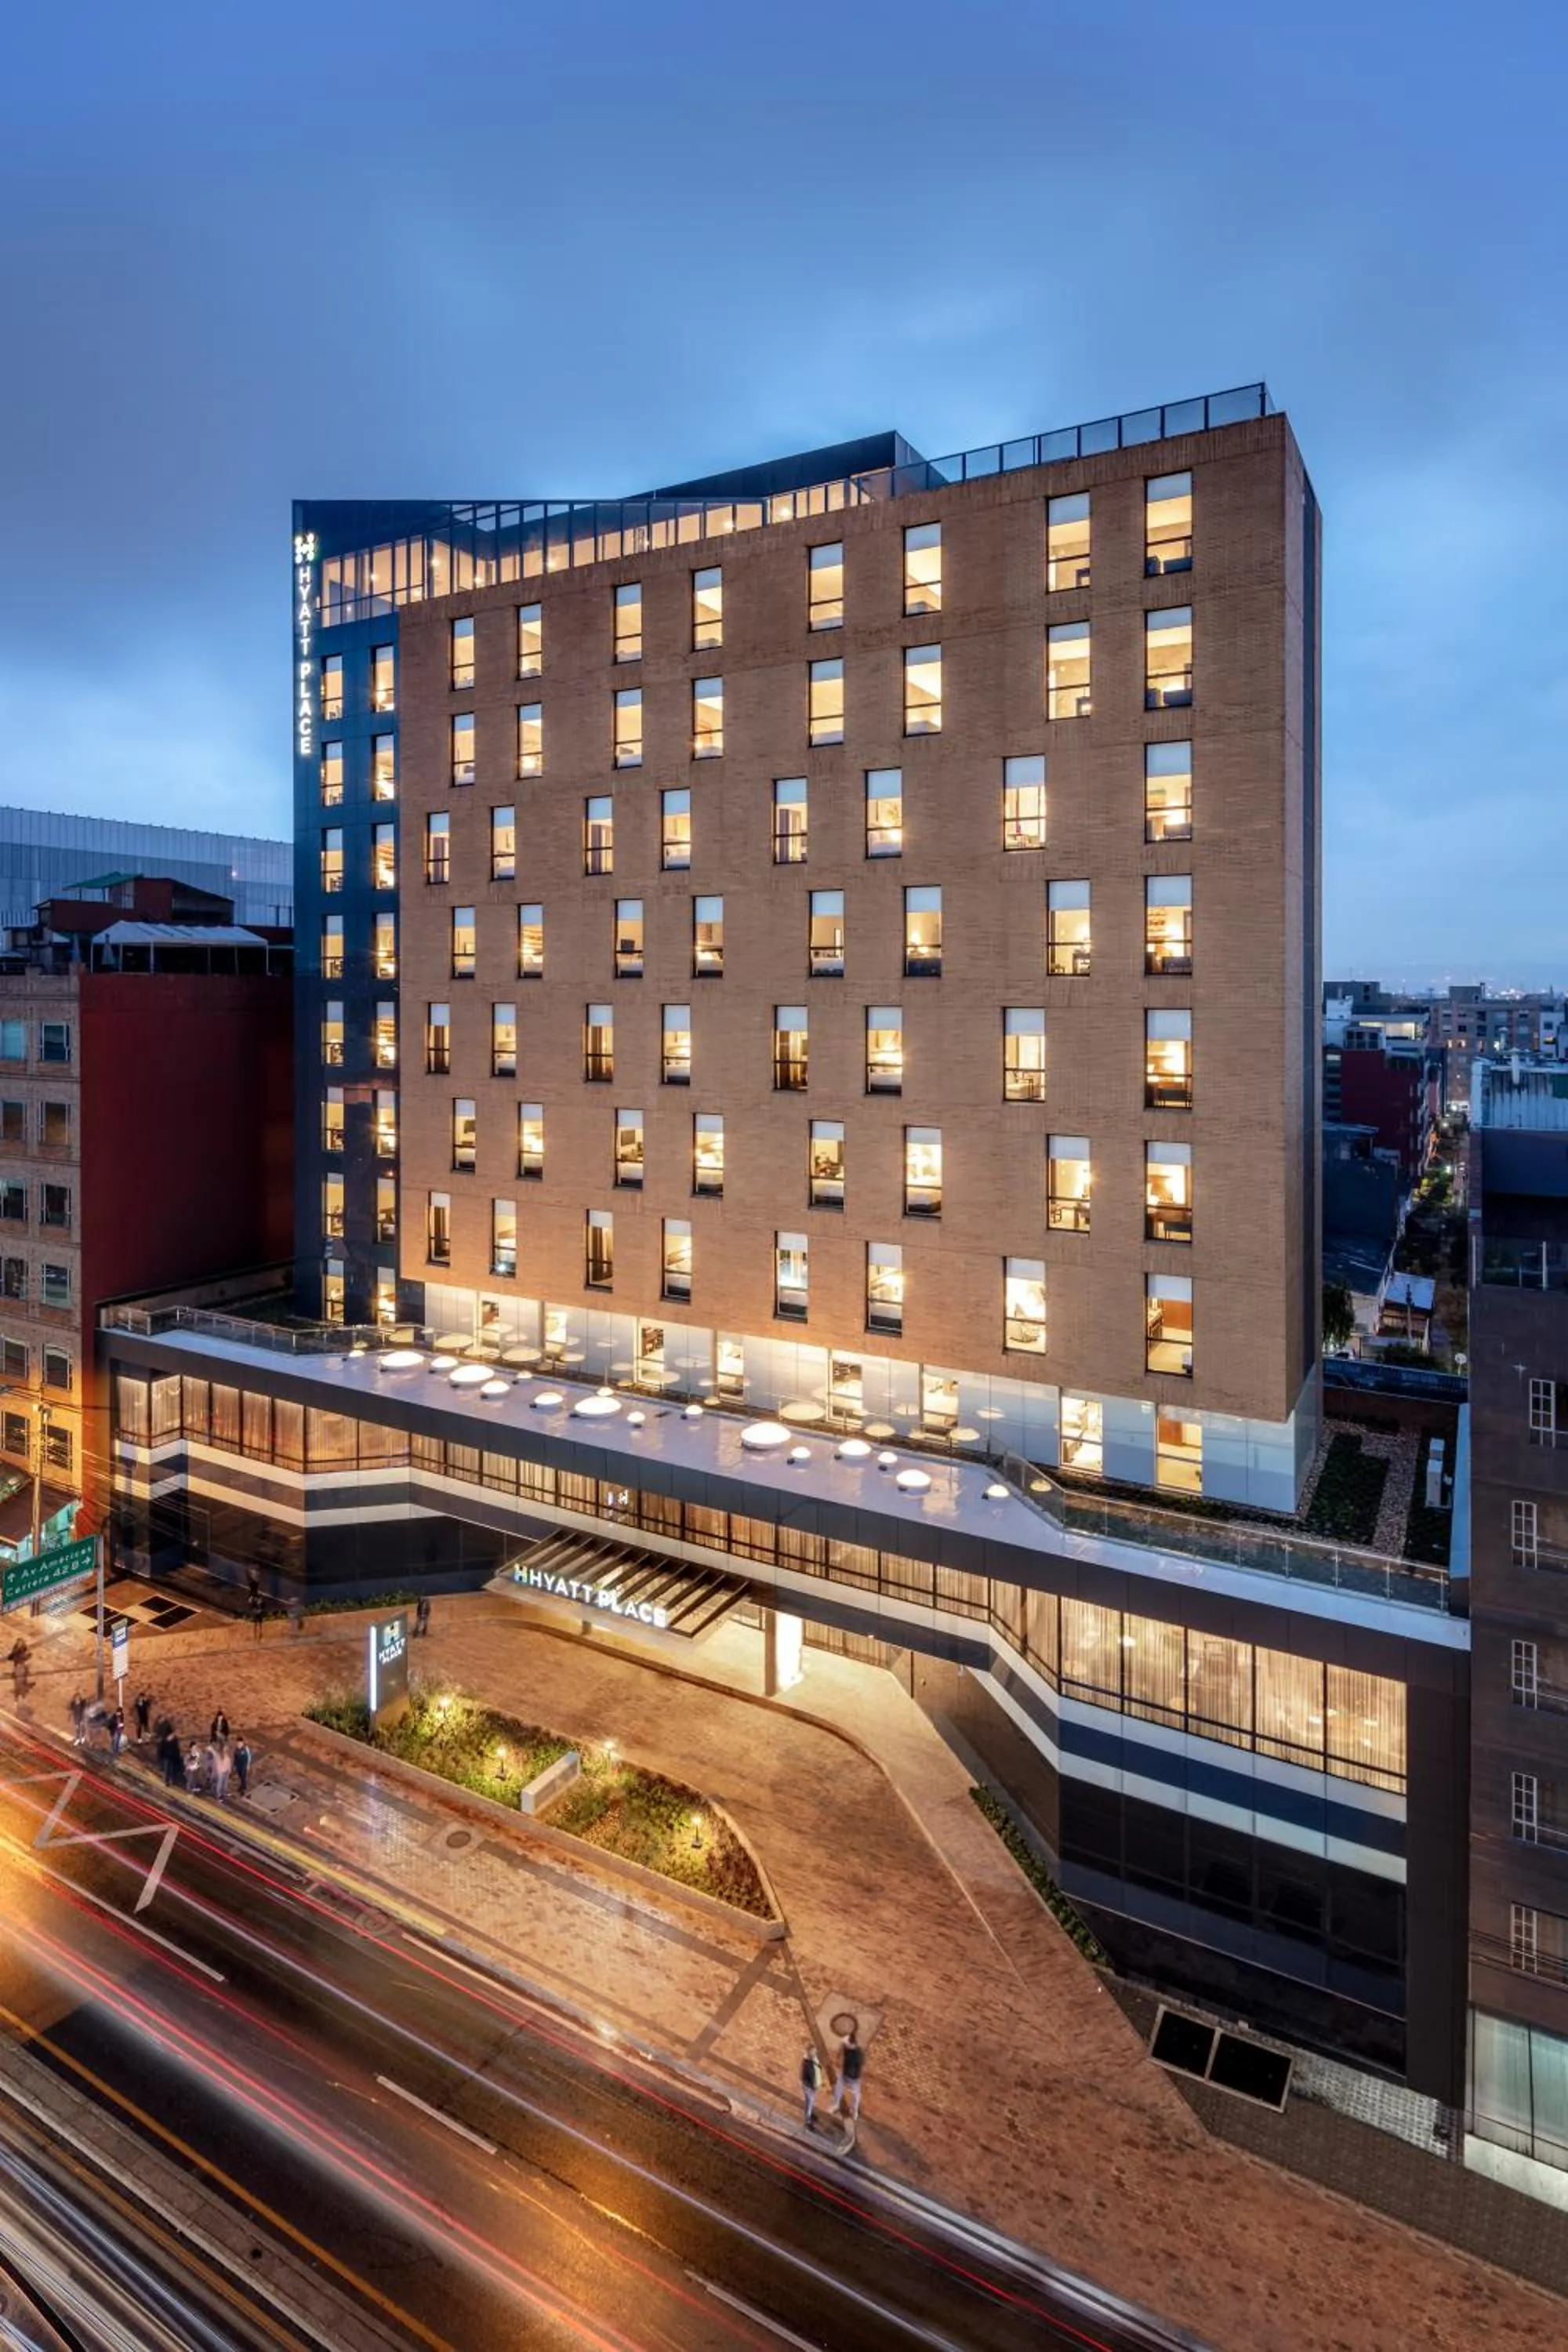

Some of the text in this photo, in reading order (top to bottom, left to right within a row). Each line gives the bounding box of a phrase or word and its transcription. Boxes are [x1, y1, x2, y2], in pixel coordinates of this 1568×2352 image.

[298, 566, 312, 754] HYATT PLACE
[53, 1564, 70, 1577] 42
[529, 1569, 593, 1603] HYATT
[597, 1588, 668, 1628] PLACE
[379, 1637, 406, 1661] HYATT
